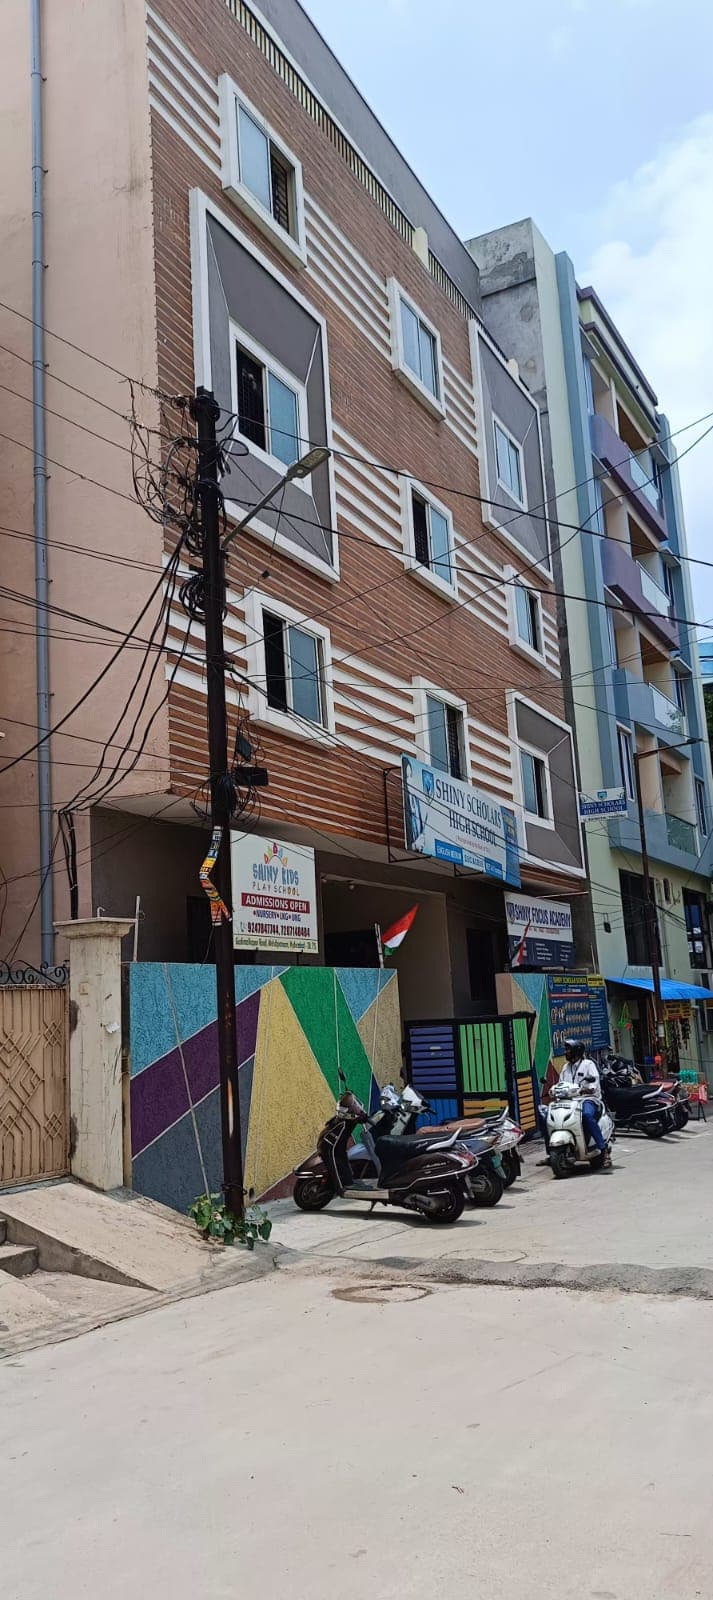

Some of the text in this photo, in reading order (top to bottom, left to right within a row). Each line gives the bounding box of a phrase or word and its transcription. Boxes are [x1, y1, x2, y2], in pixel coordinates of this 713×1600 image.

[435, 778, 465, 809] SHINY
[466, 793, 502, 828] SCHOLARS
[600, 805, 624, 813] SCHOOL
[449, 809, 471, 835] HIGH
[471, 821, 497, 847] SCHOOL
[252, 863, 299, 886] SHINY KIDS
[252, 881, 300, 896] PLAY SCHOOL
[245, 895, 307, 912] ADMISSIONS OPEN
[514, 904, 571, 927] SHINY FOCUS ACADEMY
